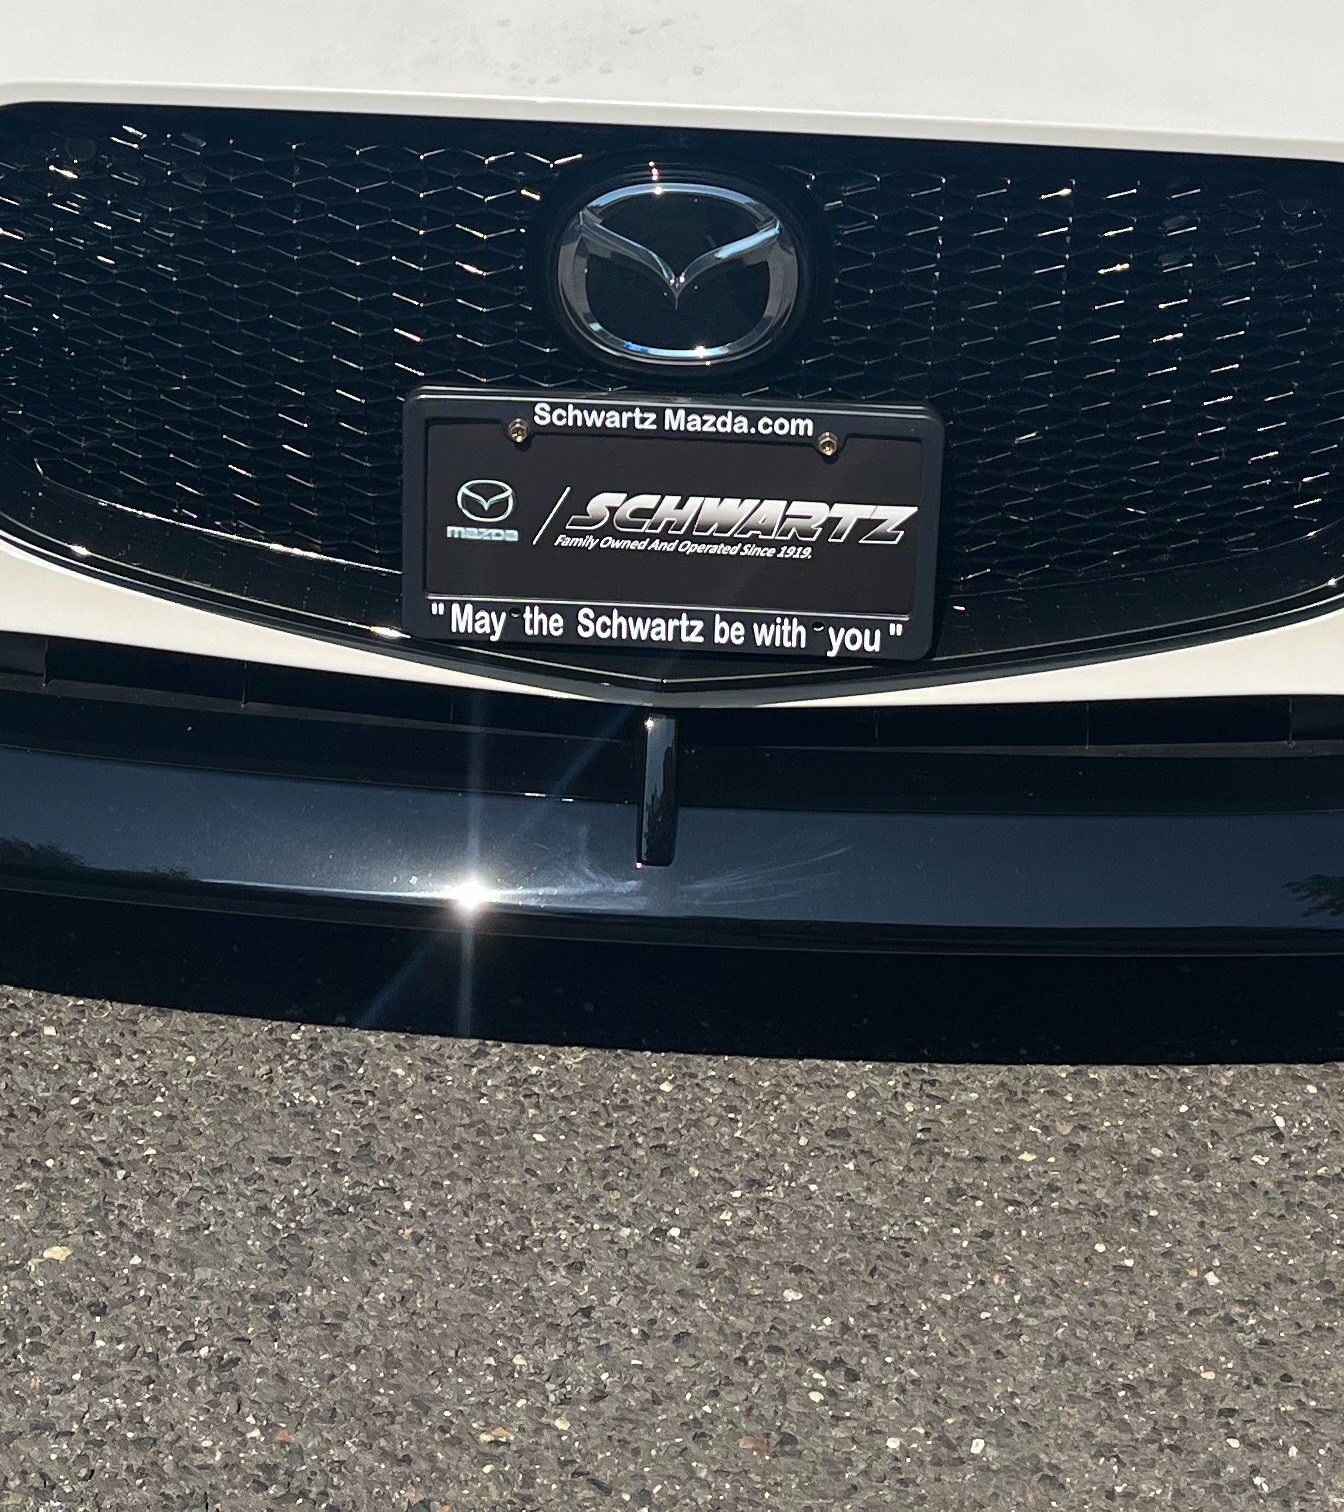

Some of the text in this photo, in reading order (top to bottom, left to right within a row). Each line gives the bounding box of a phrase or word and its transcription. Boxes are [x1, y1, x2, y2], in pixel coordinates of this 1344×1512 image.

[533, 402, 814, 437] Schwartz Mazda.com
[565, 491, 919, 545] SCHWARTZ
[554, 534, 813, 560] Family Owned And Operated Since 1919.
[522, 605, 564, 637] the
[577, 607, 705, 643] Schwartz
[714, 613, 746, 645] be
[753, 616, 807, 648] with
